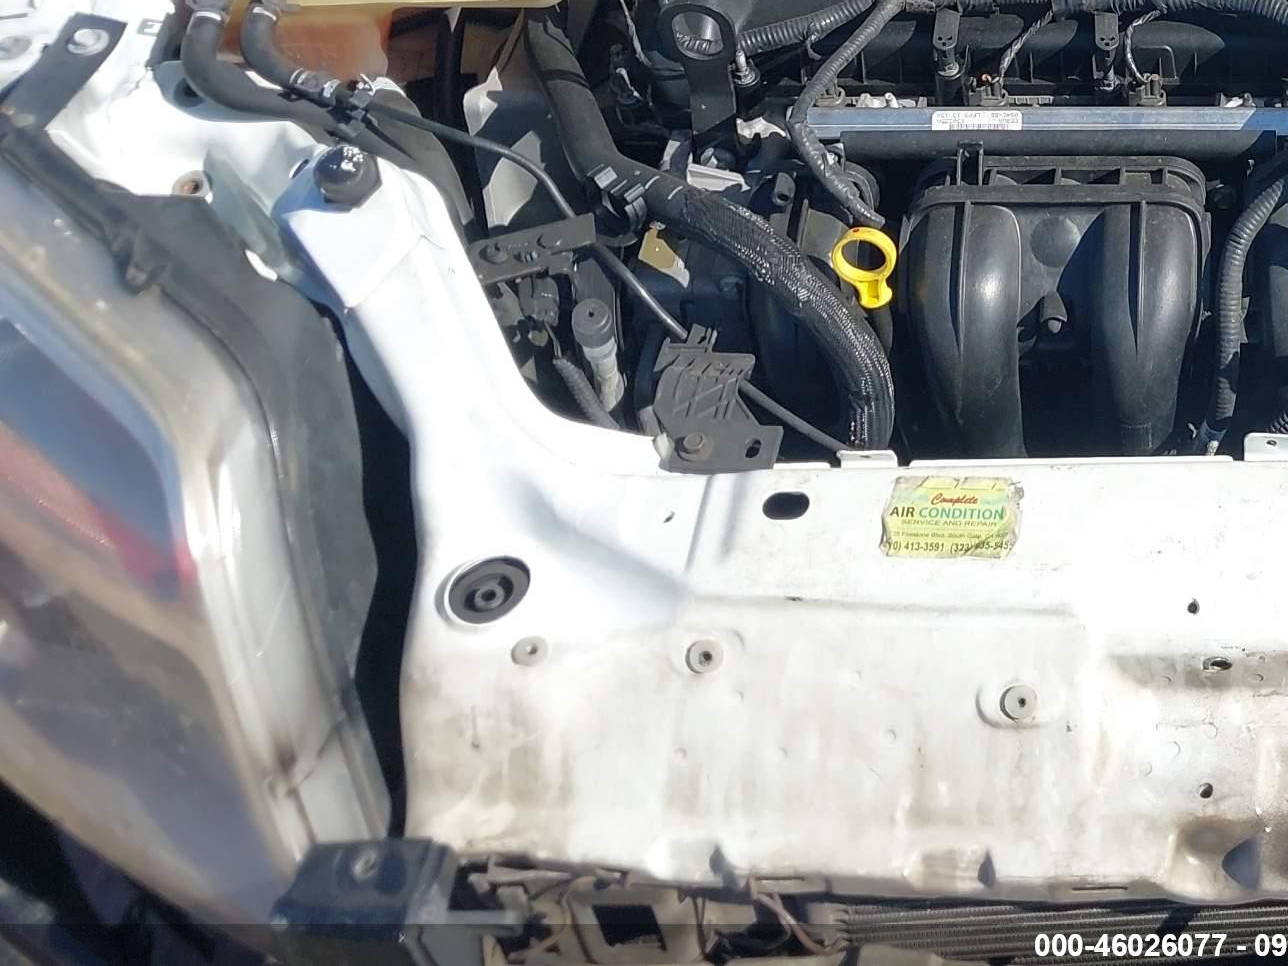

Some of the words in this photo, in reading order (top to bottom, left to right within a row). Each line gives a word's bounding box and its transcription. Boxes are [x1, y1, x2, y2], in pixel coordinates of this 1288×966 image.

[931, 492, 978, 506] Complete
[889, 506, 916, 518] AIR
[919, 506, 1005, 520] CONDITION
[943, 519, 962, 527] AND
[964, 520, 997, 528] REPAIR
[904, 541, 945, 552] 413-3591
